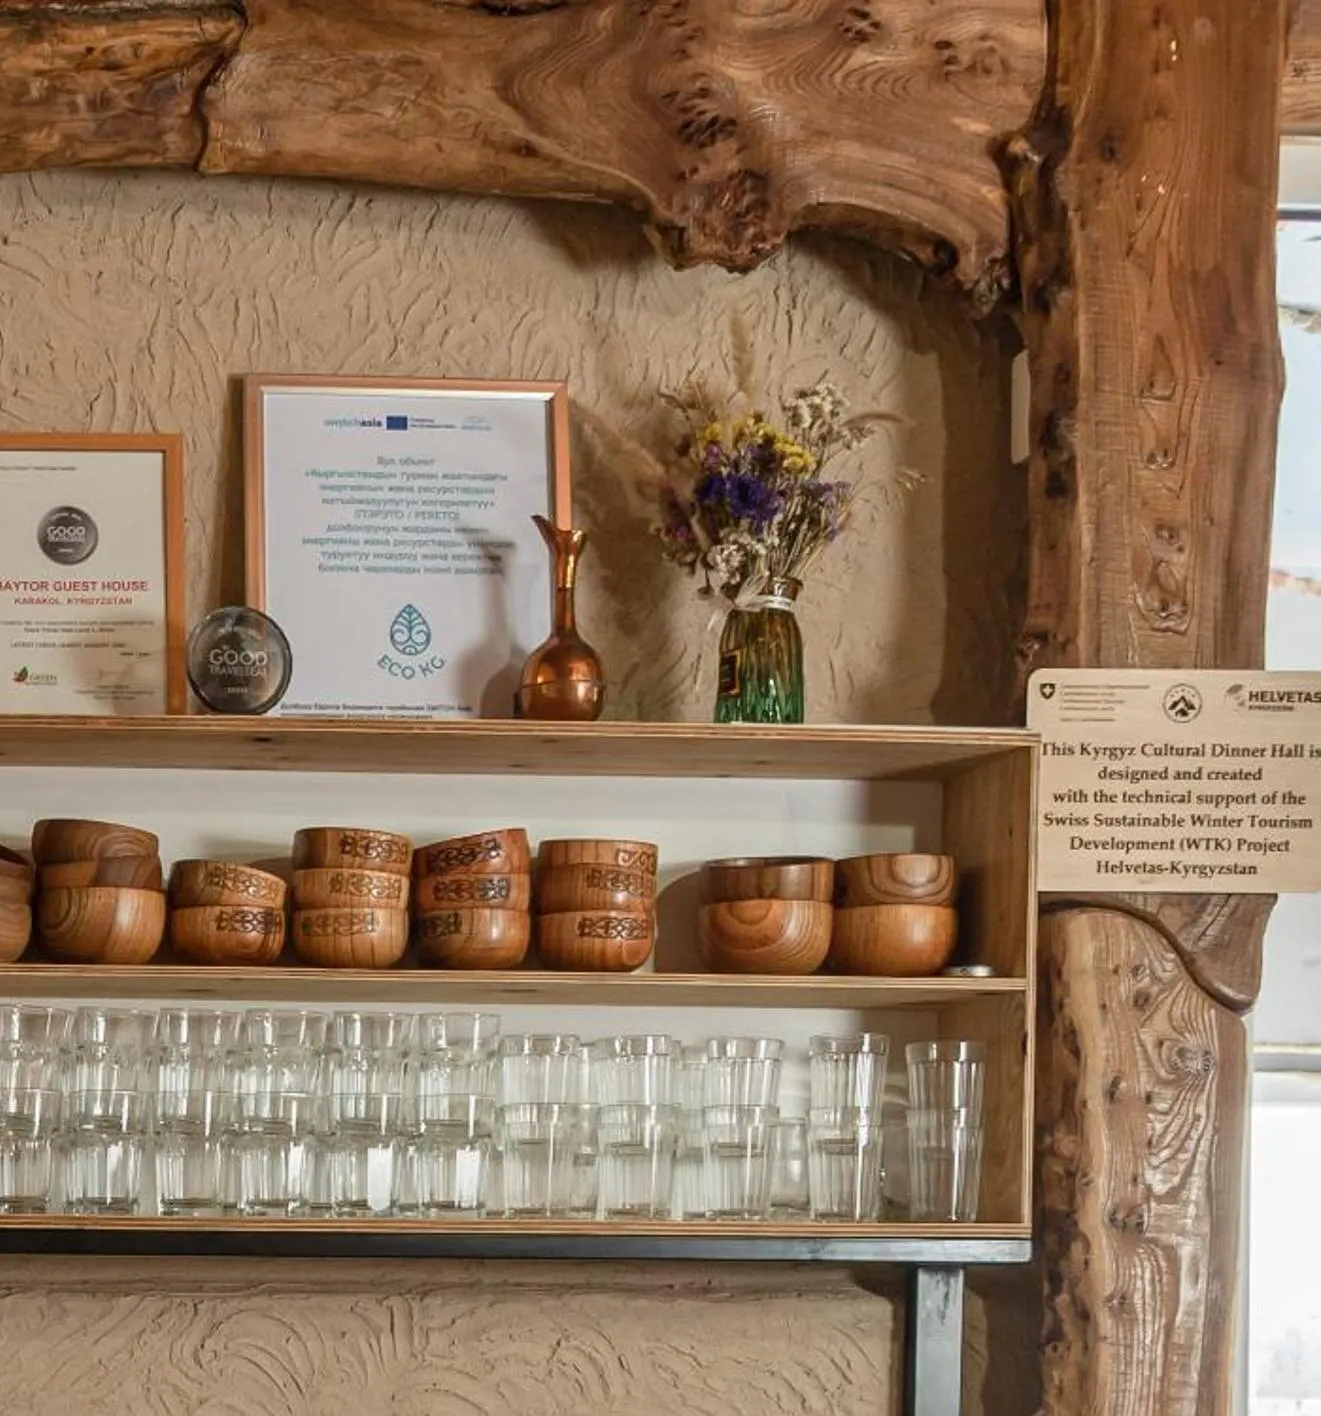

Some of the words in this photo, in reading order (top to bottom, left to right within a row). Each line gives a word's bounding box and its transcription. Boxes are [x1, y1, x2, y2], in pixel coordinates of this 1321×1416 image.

[47, 526, 86, 537] GOOD
[53, 581, 97, 592] GUEST
[101, 581, 149, 592] HOUSE
[209, 648, 268, 666] GOOD
[376, 656, 415, 682] ECO
[421, 655, 447, 678] KG
[1248, 690, 1321, 703] HELVETAS
[1042, 742, 1075, 757] This
[1080, 742, 1136, 762] Kyrgyz
[1141, 742, 1205, 758] Cultural
[1211, 743, 1267, 758] Dinner
[1270, 743, 1305, 758] Hall
[1098, 766, 1169, 783] designed
[1173, 766, 1203, 780] and
[1207, 767, 1263, 780] created
[1053, 789, 1088, 803] with
[1093, 789, 1118, 803] the
[1122, 789, 1192, 804] technical
[1196, 791, 1257, 808] support
[1261, 790, 1279, 805] of
[1282, 790, 1307, 805] the
[1044, 814, 1089, 827] Swiss
[1094, 814, 1185, 828] Sustainable
[1190, 814, 1243, 828] Winter
[1248, 815, 1313, 829] Tourism
[1070, 836, 1175, 854] Development
[1180, 836, 1232, 852] (WTK)
[1236, 837, 1290, 855] Project
[1096, 860, 1258, 879] Helvetas-Kyrgyzstan
